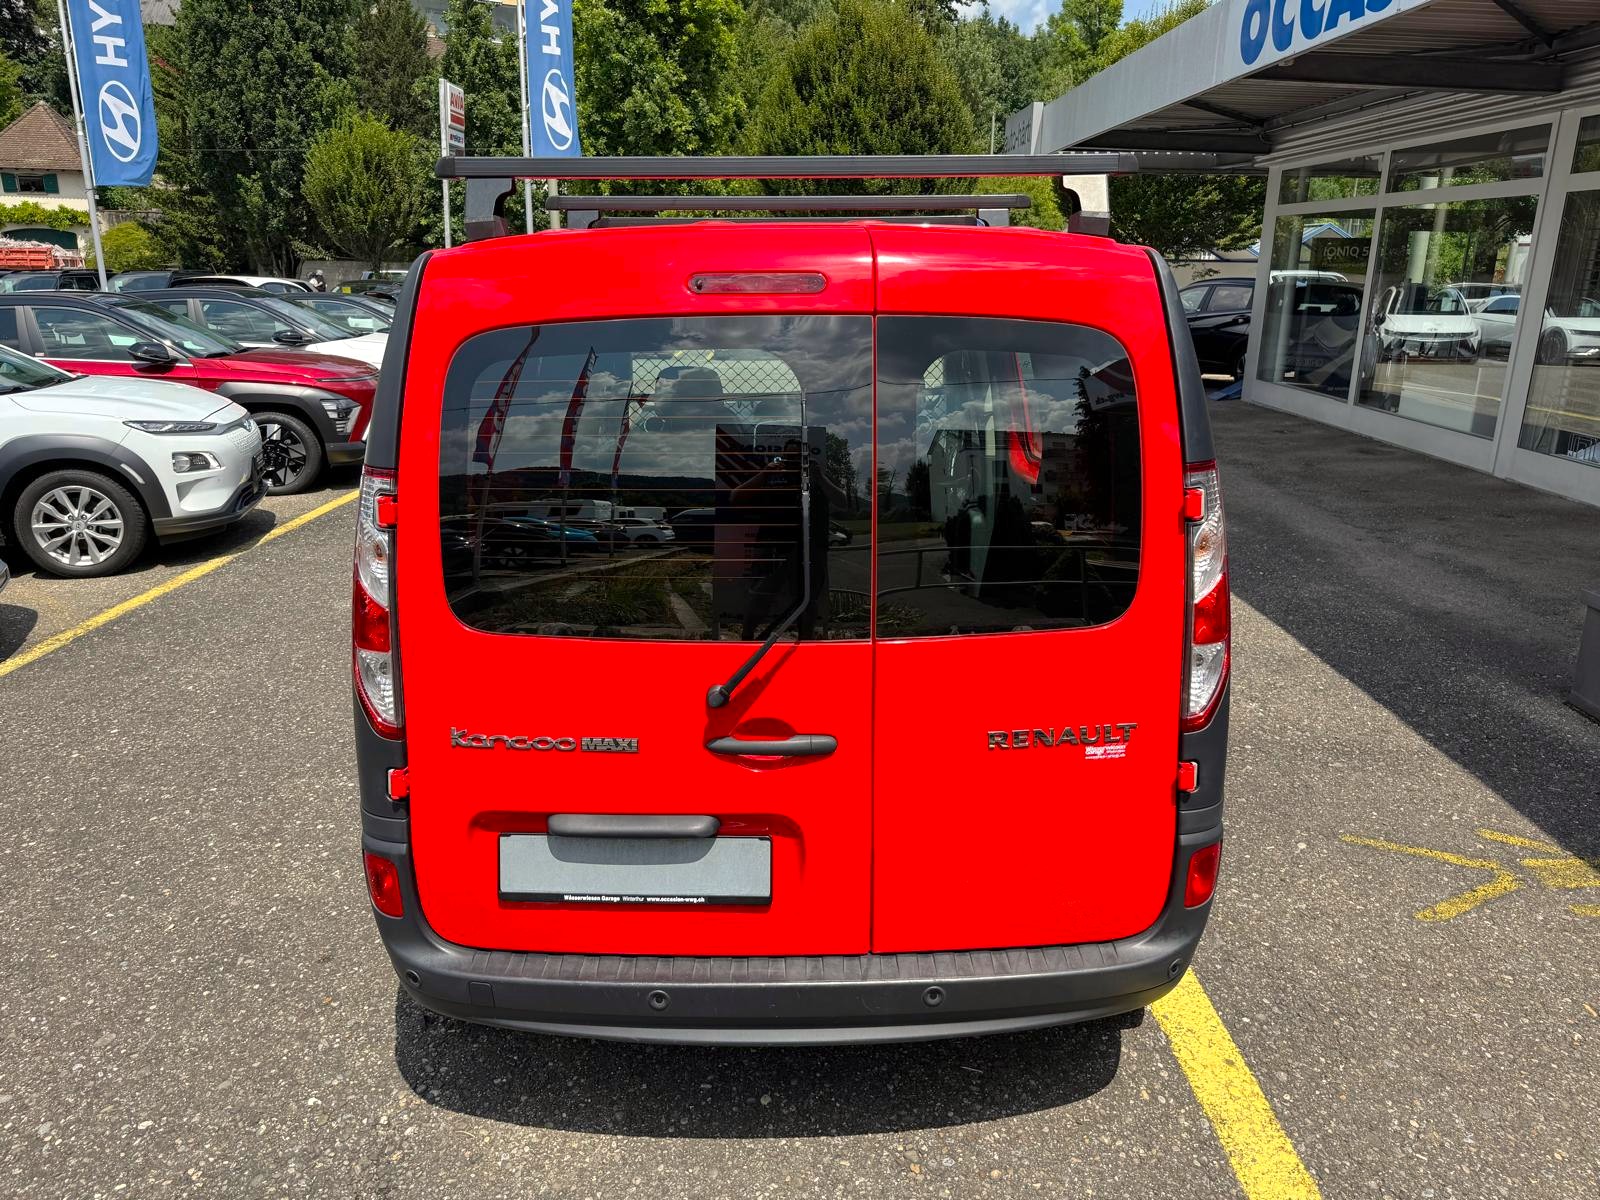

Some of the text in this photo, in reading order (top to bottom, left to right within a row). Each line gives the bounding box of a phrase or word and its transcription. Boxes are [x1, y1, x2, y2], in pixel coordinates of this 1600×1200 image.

[1240, 0, 1393, 65] OCC
[1323, 246, 1361, 258] IONIQ
[988, 723, 1138, 749] RENAULT
[581, 737, 639, 752] MAXI
[601, 895, 621, 903] Garage
